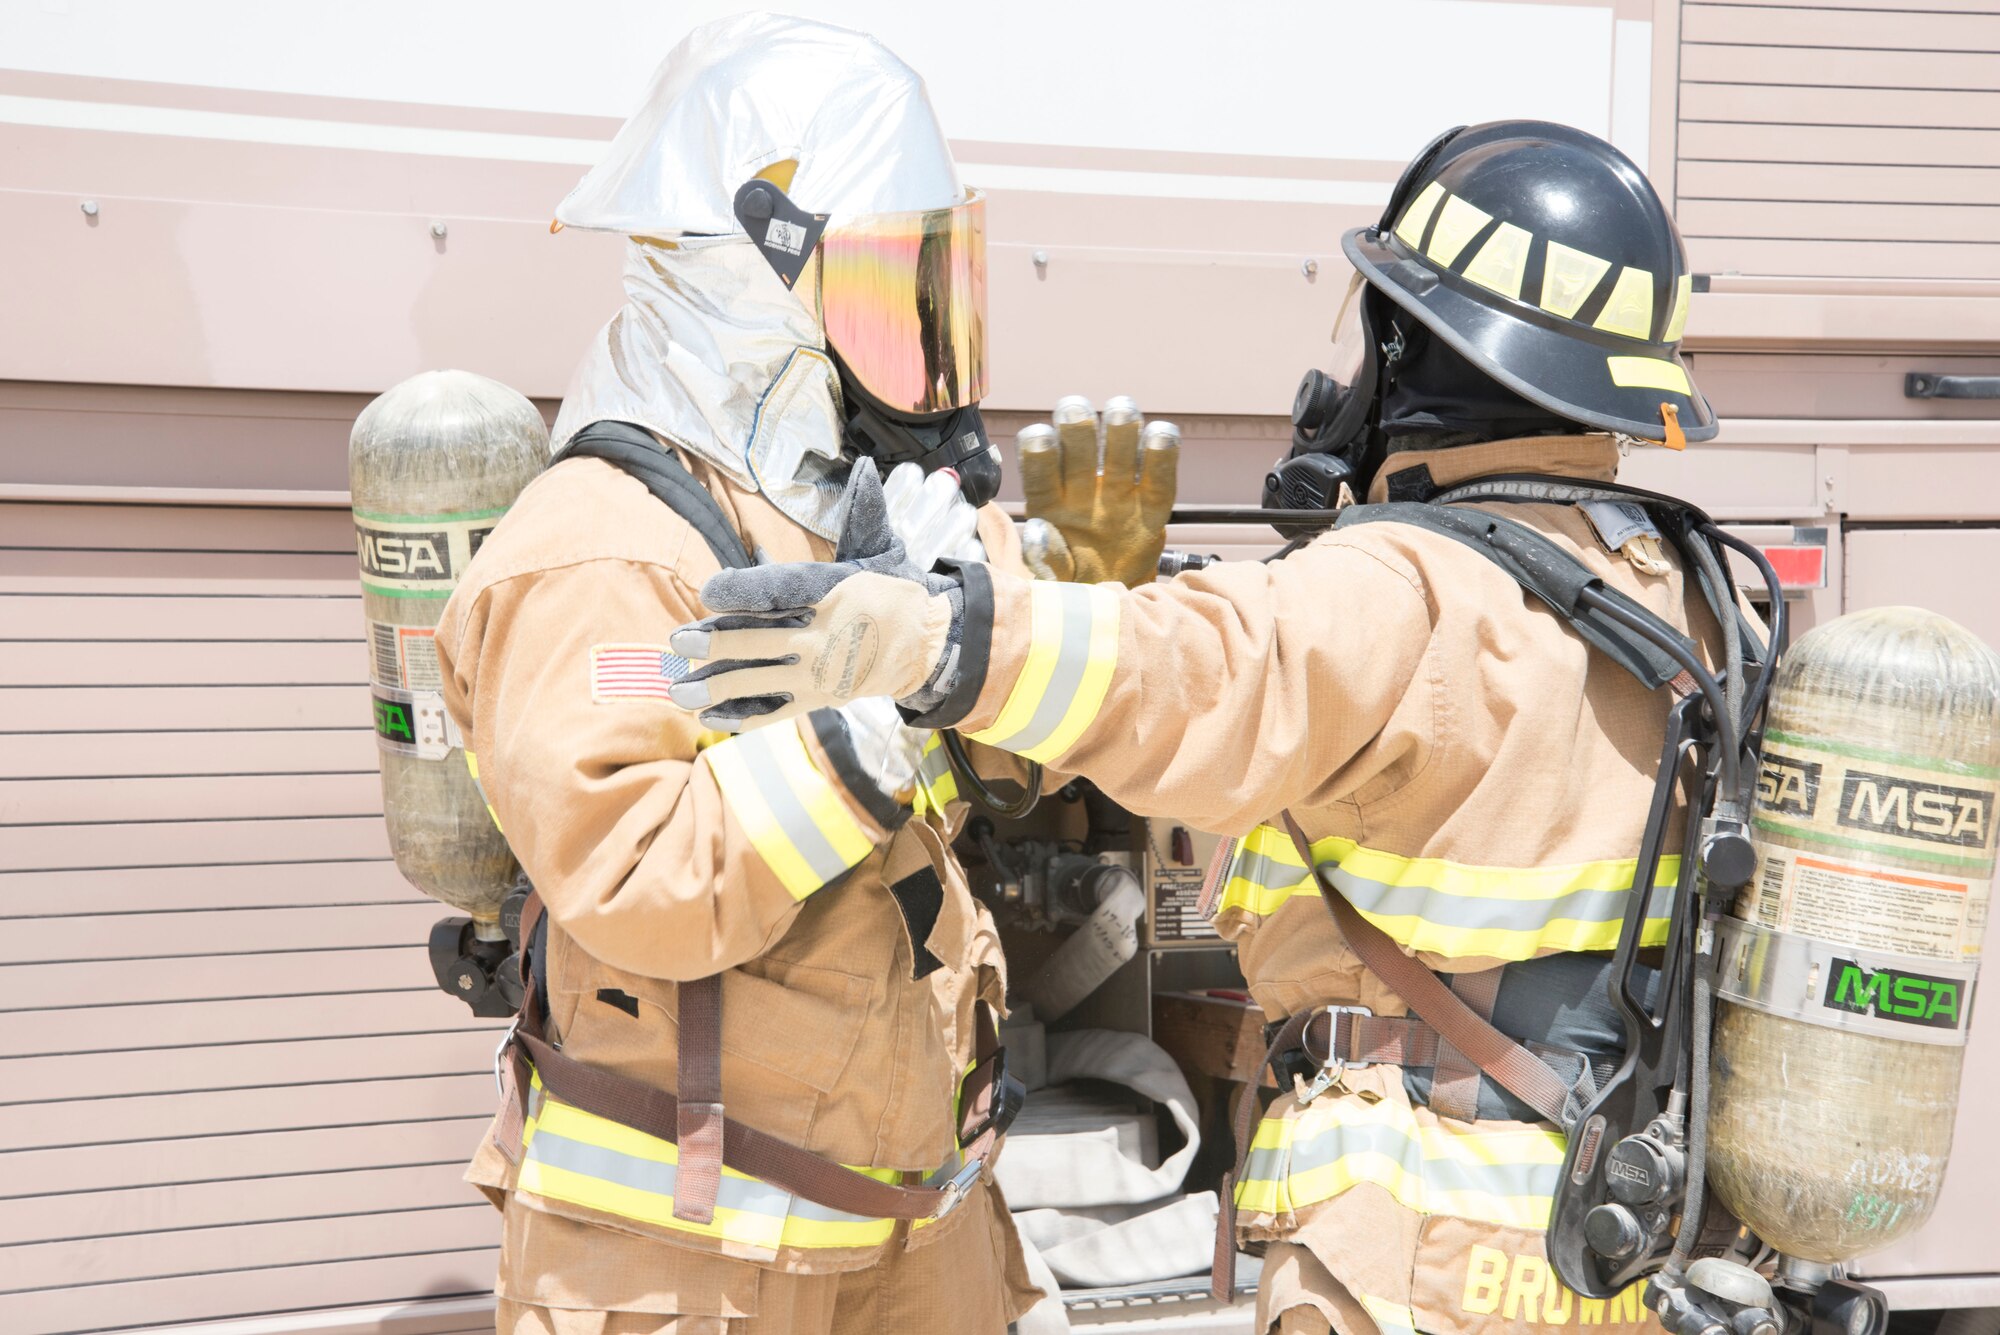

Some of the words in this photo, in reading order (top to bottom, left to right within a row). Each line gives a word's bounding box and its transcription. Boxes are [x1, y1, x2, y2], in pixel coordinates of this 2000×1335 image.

[357, 531, 444, 574] MSA
[1848, 781, 1983, 841] MSA
[1834, 965, 1958, 1023] MSA
[1610, 1159, 1649, 1186] MSA
